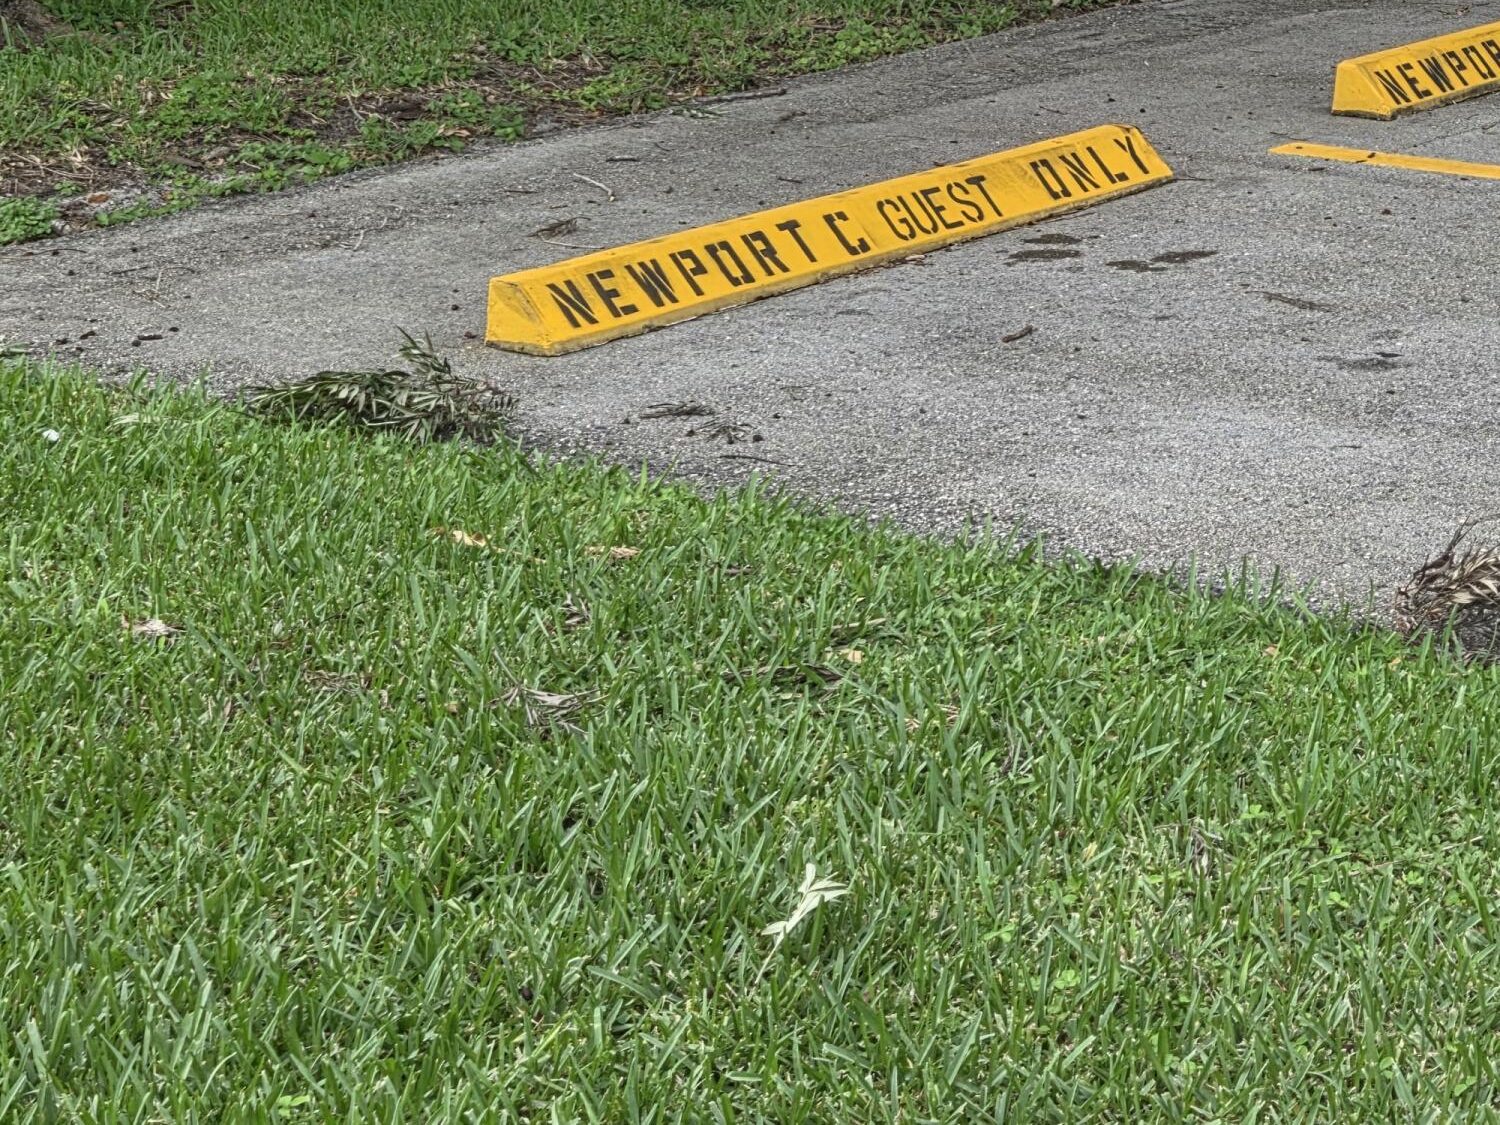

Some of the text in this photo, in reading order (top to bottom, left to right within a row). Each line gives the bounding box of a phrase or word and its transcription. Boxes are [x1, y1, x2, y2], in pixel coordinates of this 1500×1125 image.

[544, 134, 1152, 329] NEWPORT C GUEST ONLY
